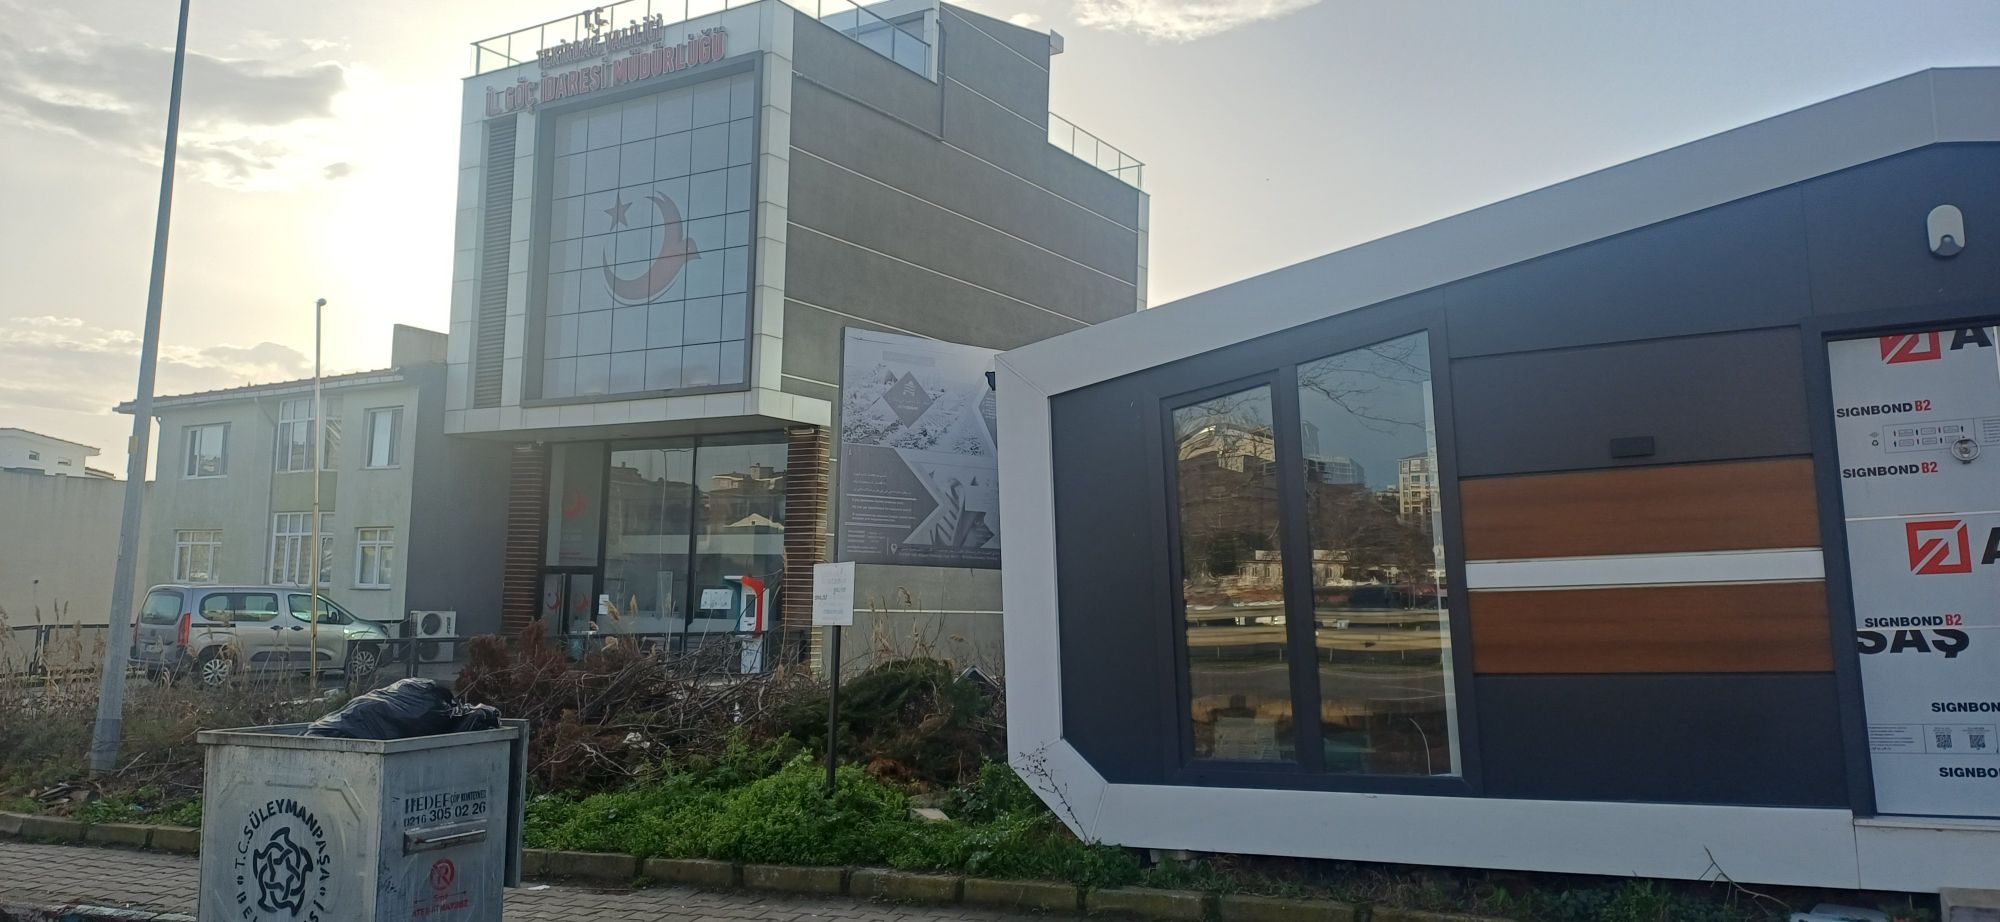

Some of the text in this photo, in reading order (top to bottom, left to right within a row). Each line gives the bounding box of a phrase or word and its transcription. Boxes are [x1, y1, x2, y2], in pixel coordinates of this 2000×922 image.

[504, 76, 537, 114] GÖÇ
[540, 56, 607, 103] İDARESİ
[612, 26, 727, 85] MÜDÜRLÜĞÜ
[1836, 399, 1932, 418] SIGNBOND B2
[1842, 461, 1938, 479] SIGNBOND B2
[1864, 613, 1962, 628] SIGNBOND B2
[1939, 767, 2000, 778] SIGNBO
[429, 807, 452, 822] 305
[455, 805, 470, 818] 02
[472, 802, 486, 815] 26
